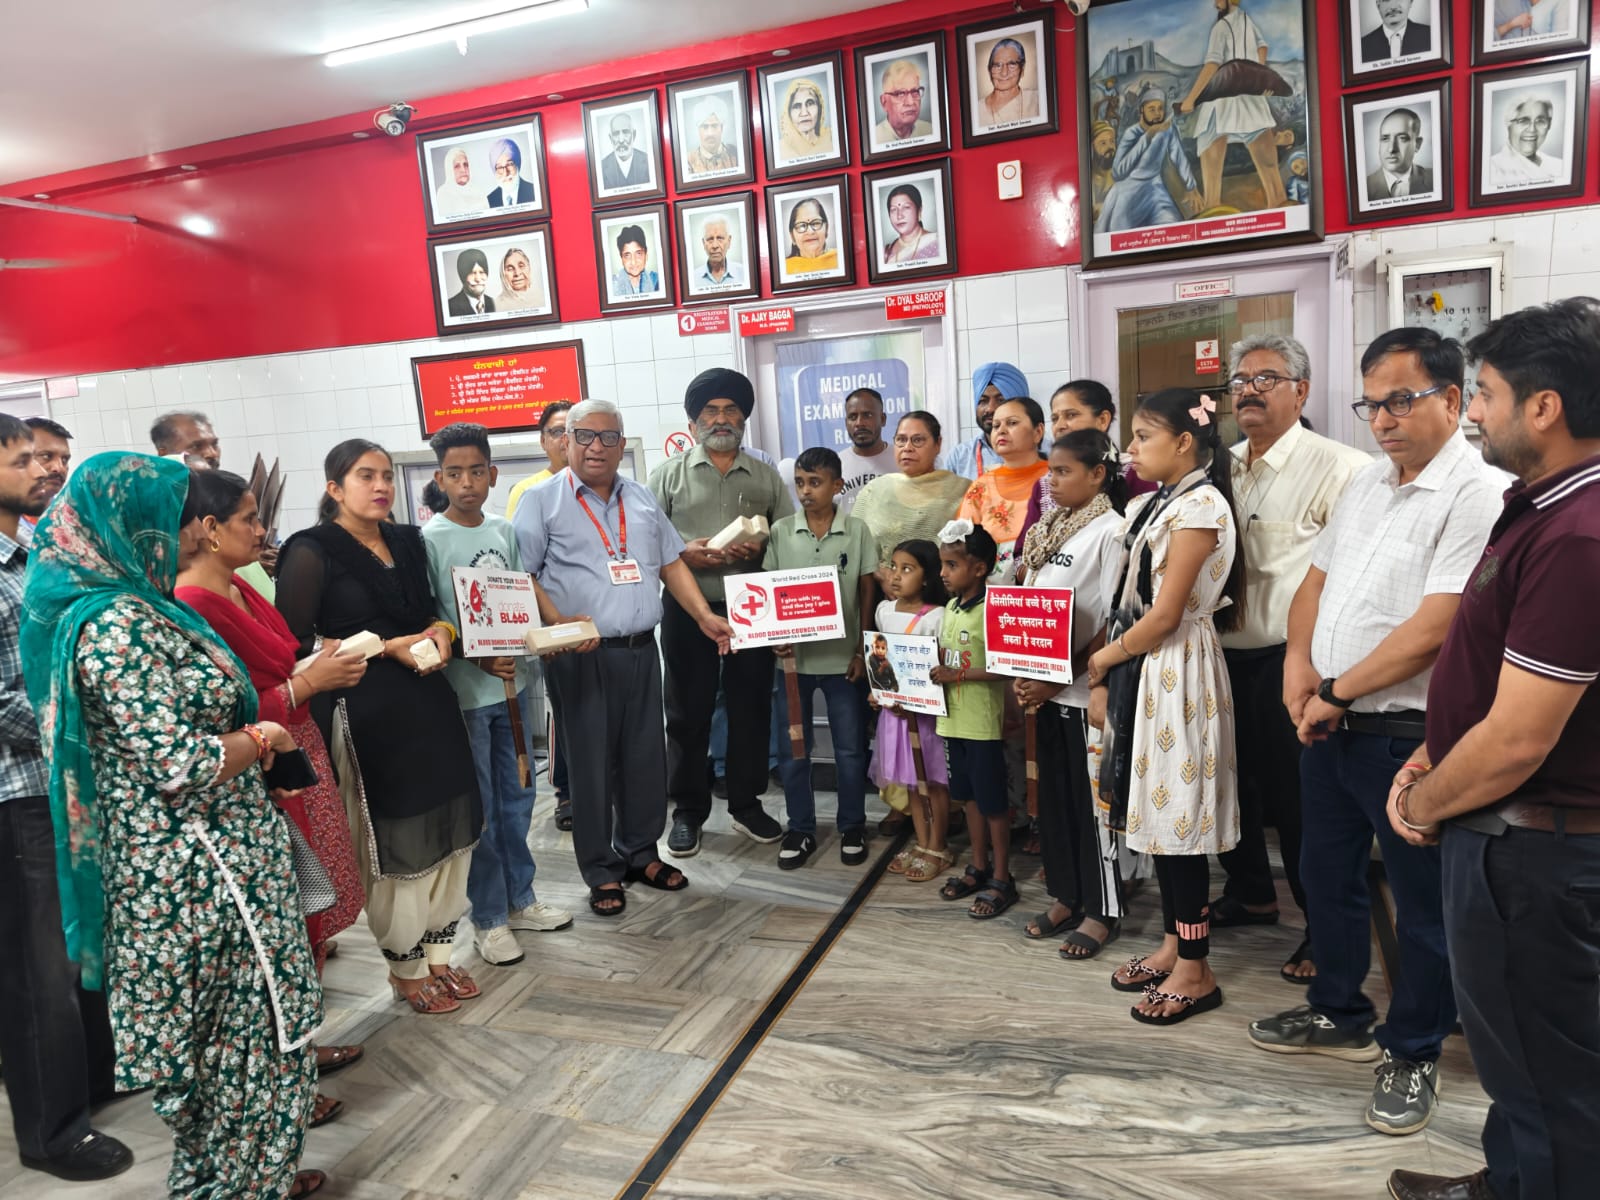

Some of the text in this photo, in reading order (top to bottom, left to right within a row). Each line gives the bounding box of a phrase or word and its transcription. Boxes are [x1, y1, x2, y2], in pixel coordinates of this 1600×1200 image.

[887, 291, 944, 307] Dr. DYAL SAROOP
[741, 308, 792, 324] Dr. AJAY BAGGA
[1445, 307, 1455, 315] 10
[1462, 307, 1470, 315] 11
[820, 372, 886, 394] MEDICAL
[840, 473, 883, 496] UNIVER
[772, 575, 788, 583] World
[818, 571, 834, 579] 2024
[782, 602, 794, 610] and
[804, 600, 814, 609] joy
[818, 599, 831, 608] give
[784, 597, 797, 605] give
[794, 607, 817, 615] reward.
[500, 611, 529, 625] BLOOD
[767, 628, 791, 637] DONORS
[791, 626, 816, 635] COUNCIL
